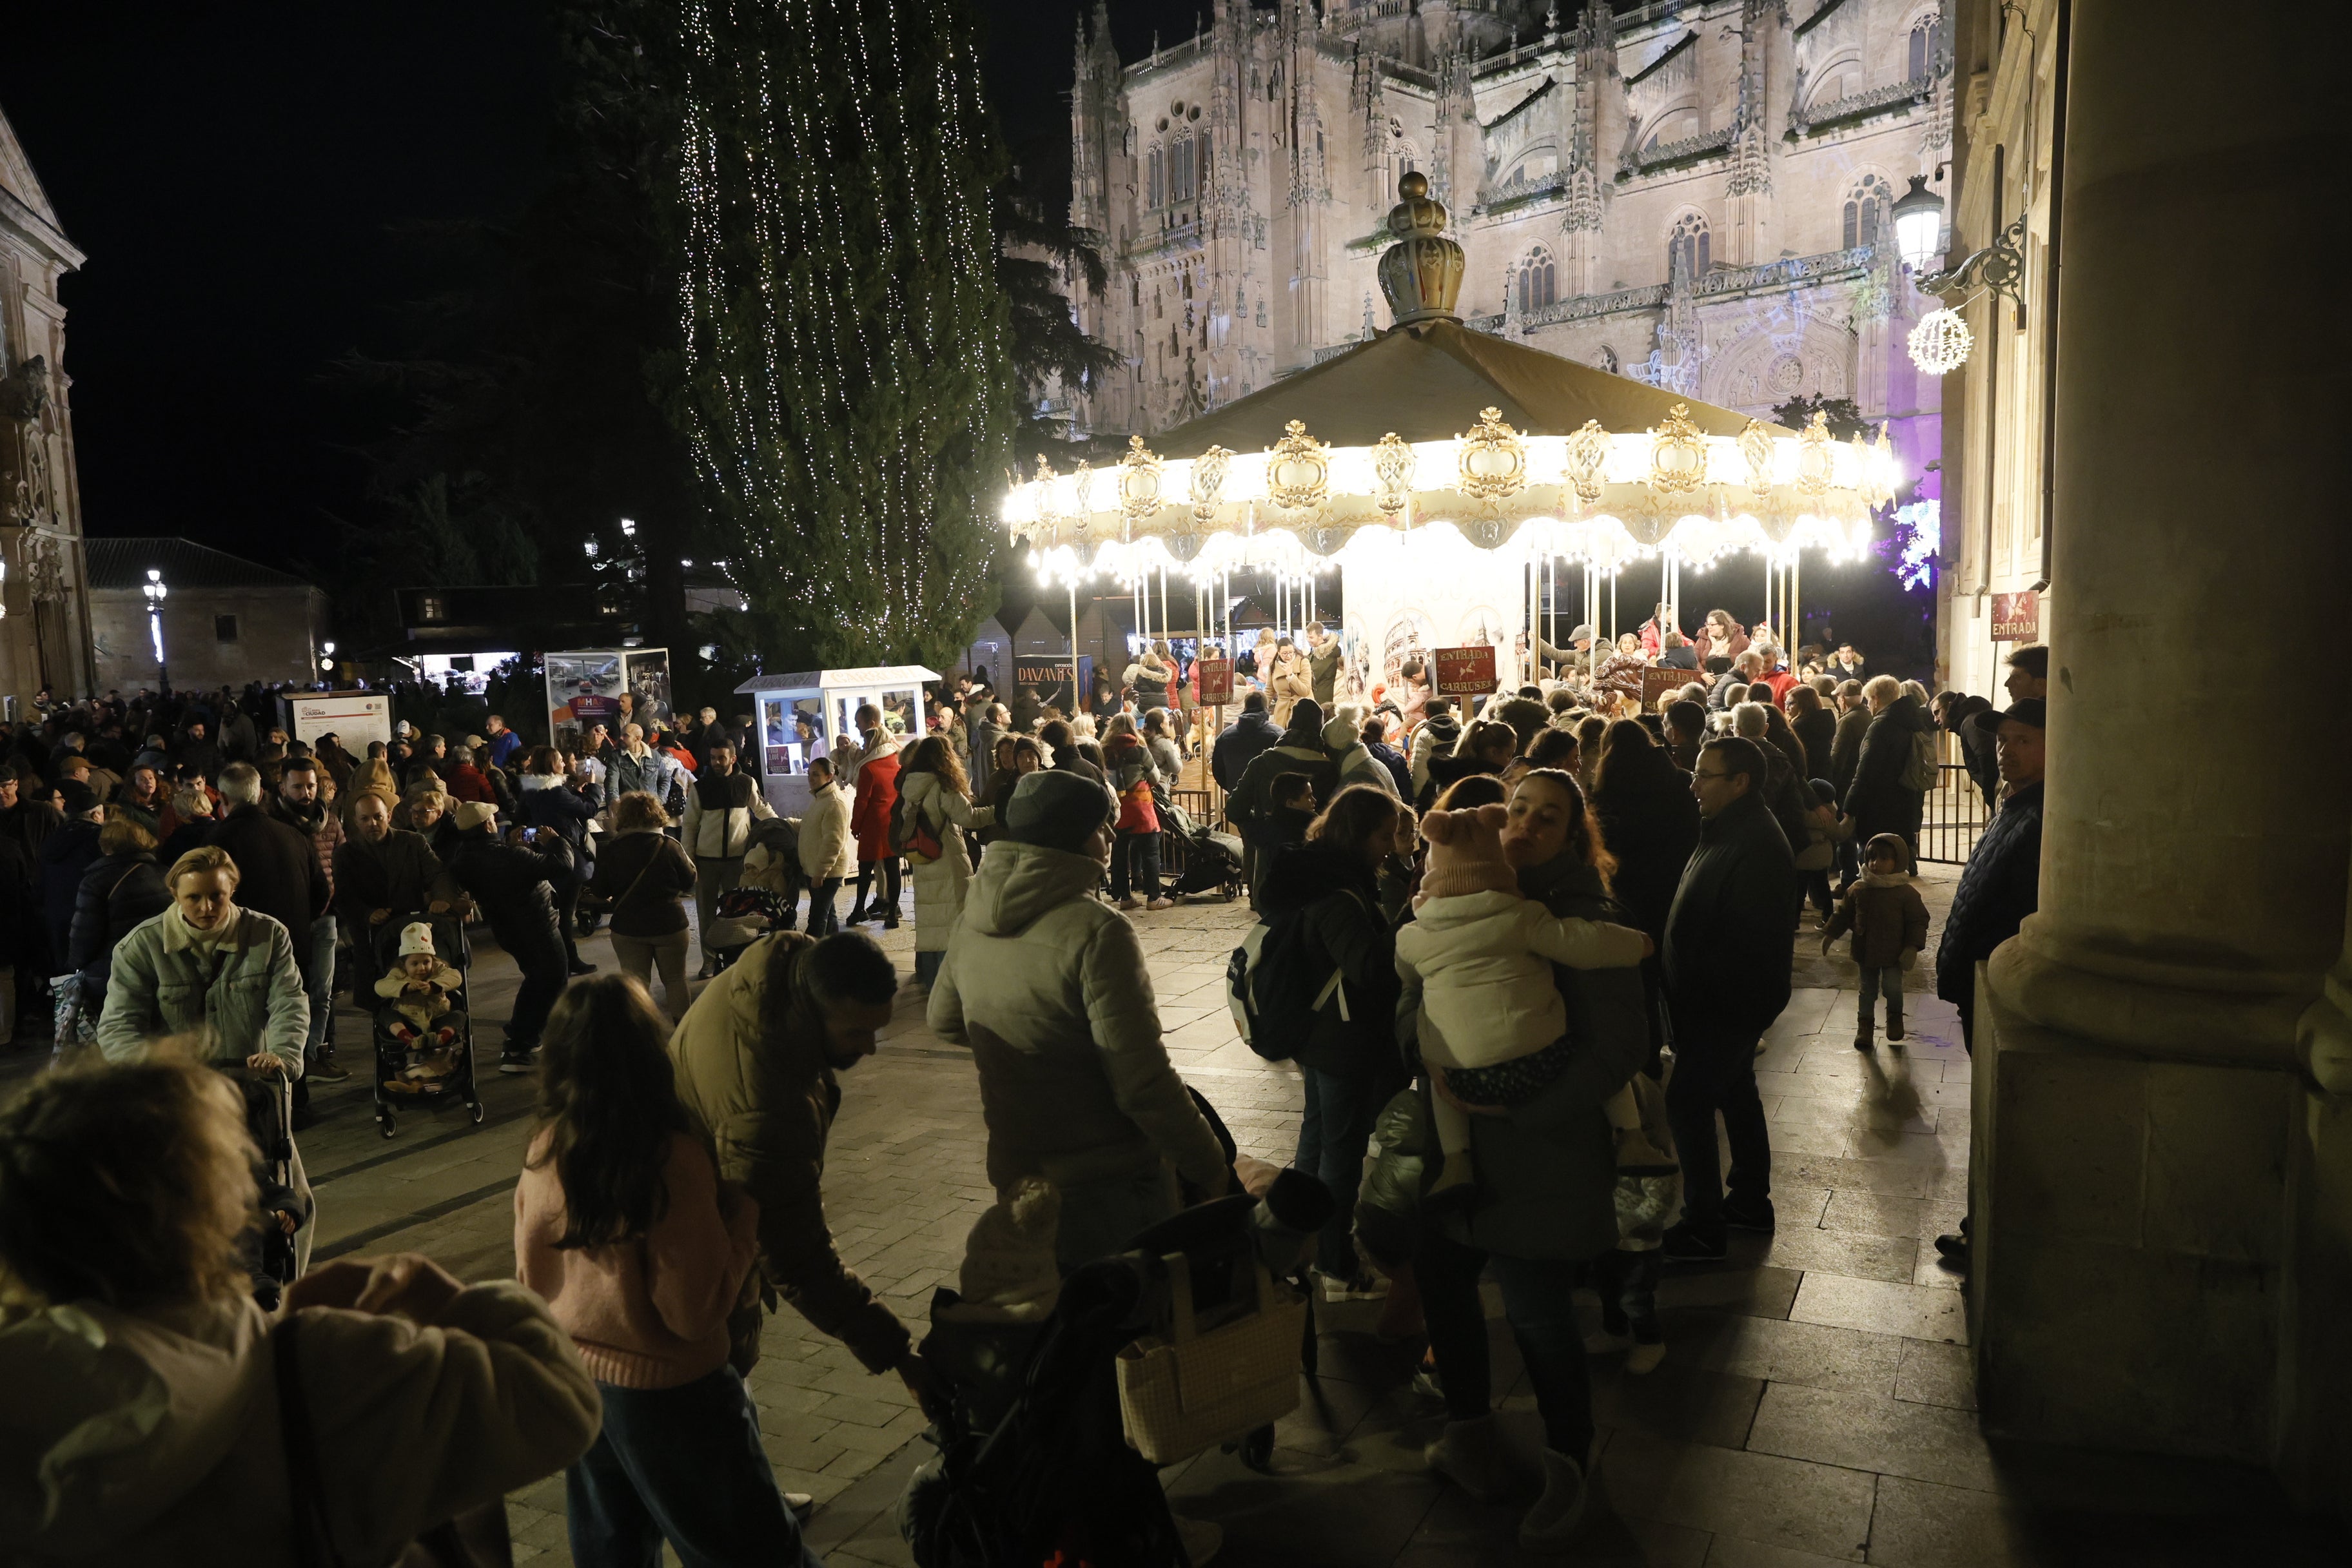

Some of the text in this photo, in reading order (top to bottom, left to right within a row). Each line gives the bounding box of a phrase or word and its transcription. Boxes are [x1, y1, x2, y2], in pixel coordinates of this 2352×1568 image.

[1993, 622, 2036, 635] ENTRADA
[1440, 649, 1488, 661] ENTRADA
[1202, 662, 1231, 672] ENTRADA
[1019, 667, 1073, 681] DANZANTES
[1648, 671, 1694, 682] ENTRADA
[1440, 680, 1493, 692] CARRUSEL
